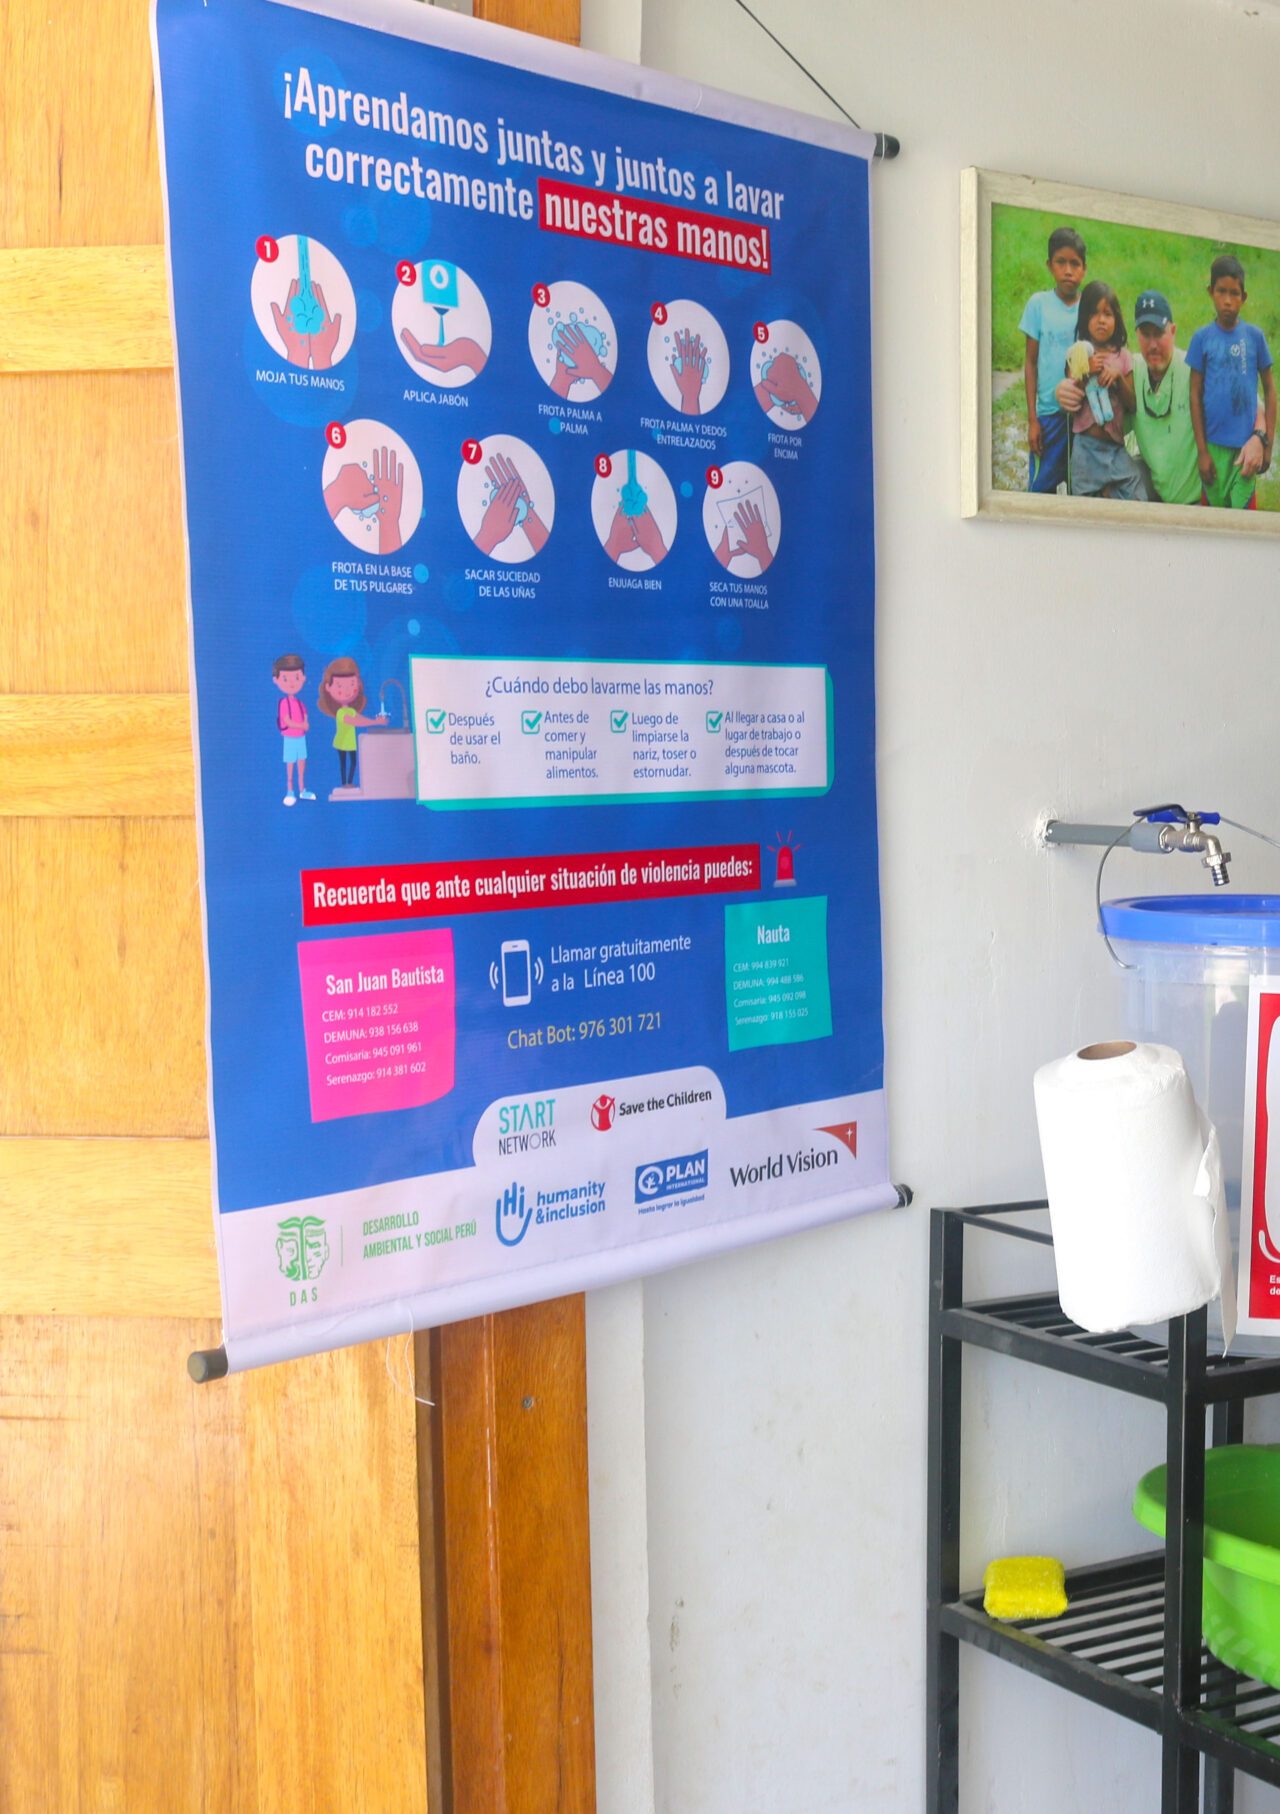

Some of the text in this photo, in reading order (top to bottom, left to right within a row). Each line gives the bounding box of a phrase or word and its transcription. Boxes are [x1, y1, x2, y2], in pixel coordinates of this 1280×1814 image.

[284, 67, 784, 220] ¡Aprendamos juntas y juntos a lavar
[305, 143, 768, 268] correctamente nuestras manos!
[264, 241, 270, 257] 1
[402, 266, 410, 282] 2
[537, 288, 546, 303] 3
[654, 306, 664, 321] 4
[757, 326, 765, 341] 5
[256, 370, 345, 391] MOJA TUS MANOS
[403, 390, 468, 407] APLICA JABÓN
[332, 428, 342, 444] 6
[468, 444, 477, 460] 7
[599, 458, 607, 473] 8
[711, 470, 719, 485] 9
[332, 562, 412, 578] FROTA EN LA BASE
[464, 568, 540, 583] SACAR SUCIEDAD
[334, 579, 412, 595] DE TUS PULGARES
[479, 584, 535, 599] DE LAS UÑAS
[608, 577, 661, 590] ENJUAGA BIEN
[709, 582, 768, 595] SECA TUS MANOS
[710, 596, 769, 609] CON UNA TOALLA
[485, 676, 713, 698] ¿Cuándo debo lavarme las manos?
[449, 712, 495, 729] Después
[544, 710, 589, 725] Antes de
[632, 712, 678, 728] Luego de
[450, 731, 501, 745] de usar el
[545, 730, 585, 746] comer y
[632, 729, 689, 745] limpiarse la
[451, 750, 481, 766] baño.
[546, 747, 597, 763] manipular
[633, 747, 696, 763] nariz, toser o
[546, 765, 599, 780] alimentos.
[633, 765, 692, 778] estornudar.
[314, 859, 752, 908] Recuerda que ante cualquier situación de violencia puedes:
[757, 924, 790, 945] Nauta
[551, 934, 691, 964] Llamar gratuitamente
[327, 966, 444, 994] San Juan Bautista
[552, 963, 655, 991] a la Línea 100
[322, 1004, 398, 1022] CEM: 914 182 552
[324, 1021, 419, 1044] DEMUNA: 938 156 638
[507, 1012, 662, 1049] Chat Bot: 976 301 721
[619, 1089, 711, 1117] Save the Children
[499, 1099, 556, 1131] START
[499, 1130, 557, 1155] NETWORK
[666, 1159, 705, 1181] PLAN
[730, 1147, 838, 1188] World Vision
[536, 1179, 606, 1209] humanity
[536, 1197, 606, 1225] &inclusion
[363, 1210, 419, 1236] DESARROLLO
[363, 1218, 477, 1261] AMBIENTAL Y SOCIAL PERÚ
[1270, 1287, 1280, 1295] de
